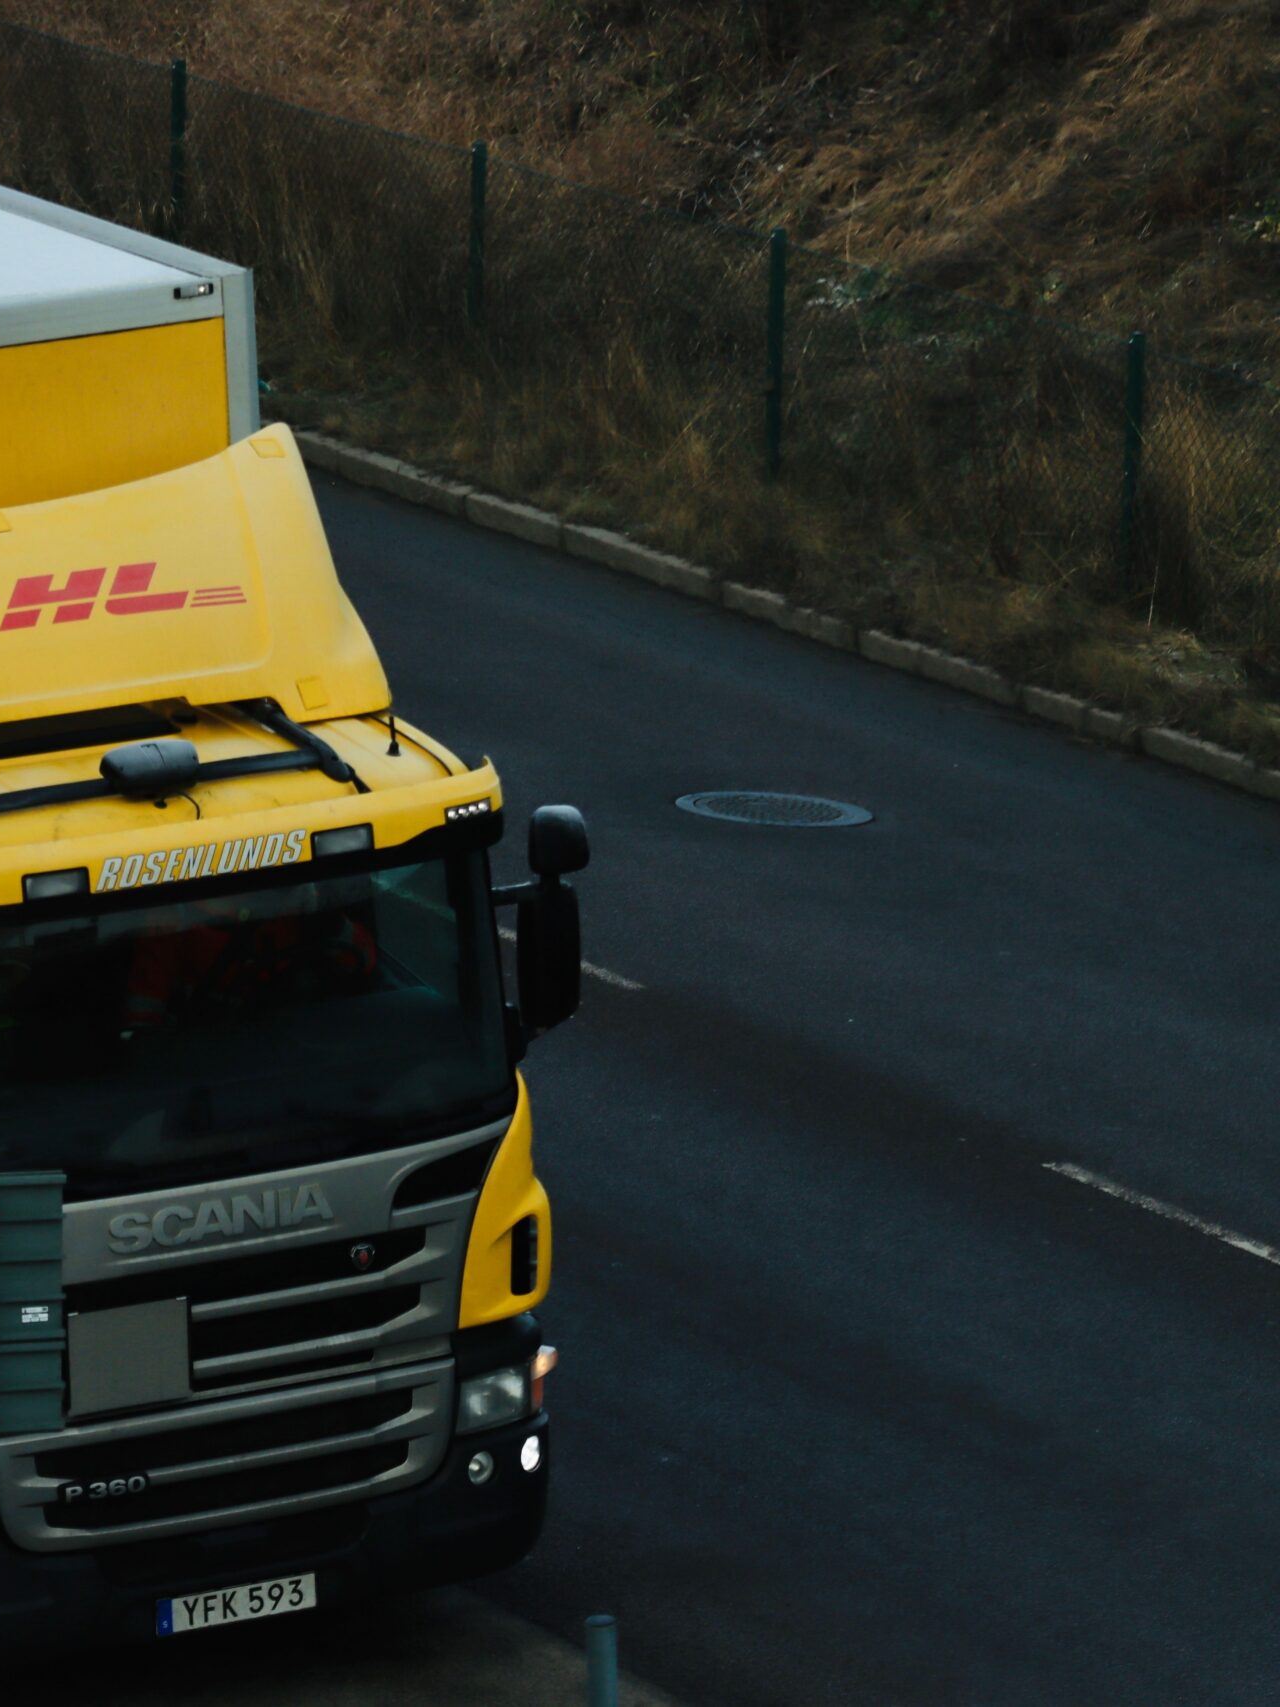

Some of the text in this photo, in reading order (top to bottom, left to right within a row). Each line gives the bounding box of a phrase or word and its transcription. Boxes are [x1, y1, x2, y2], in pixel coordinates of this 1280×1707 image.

[94, 829, 308, 893] ROSENLUNDS
[106, 1182, 335, 1255] SCANIA
[65, 1475, 146, 1505] P 360
[182, 1578, 305, 1627] YFK 593
